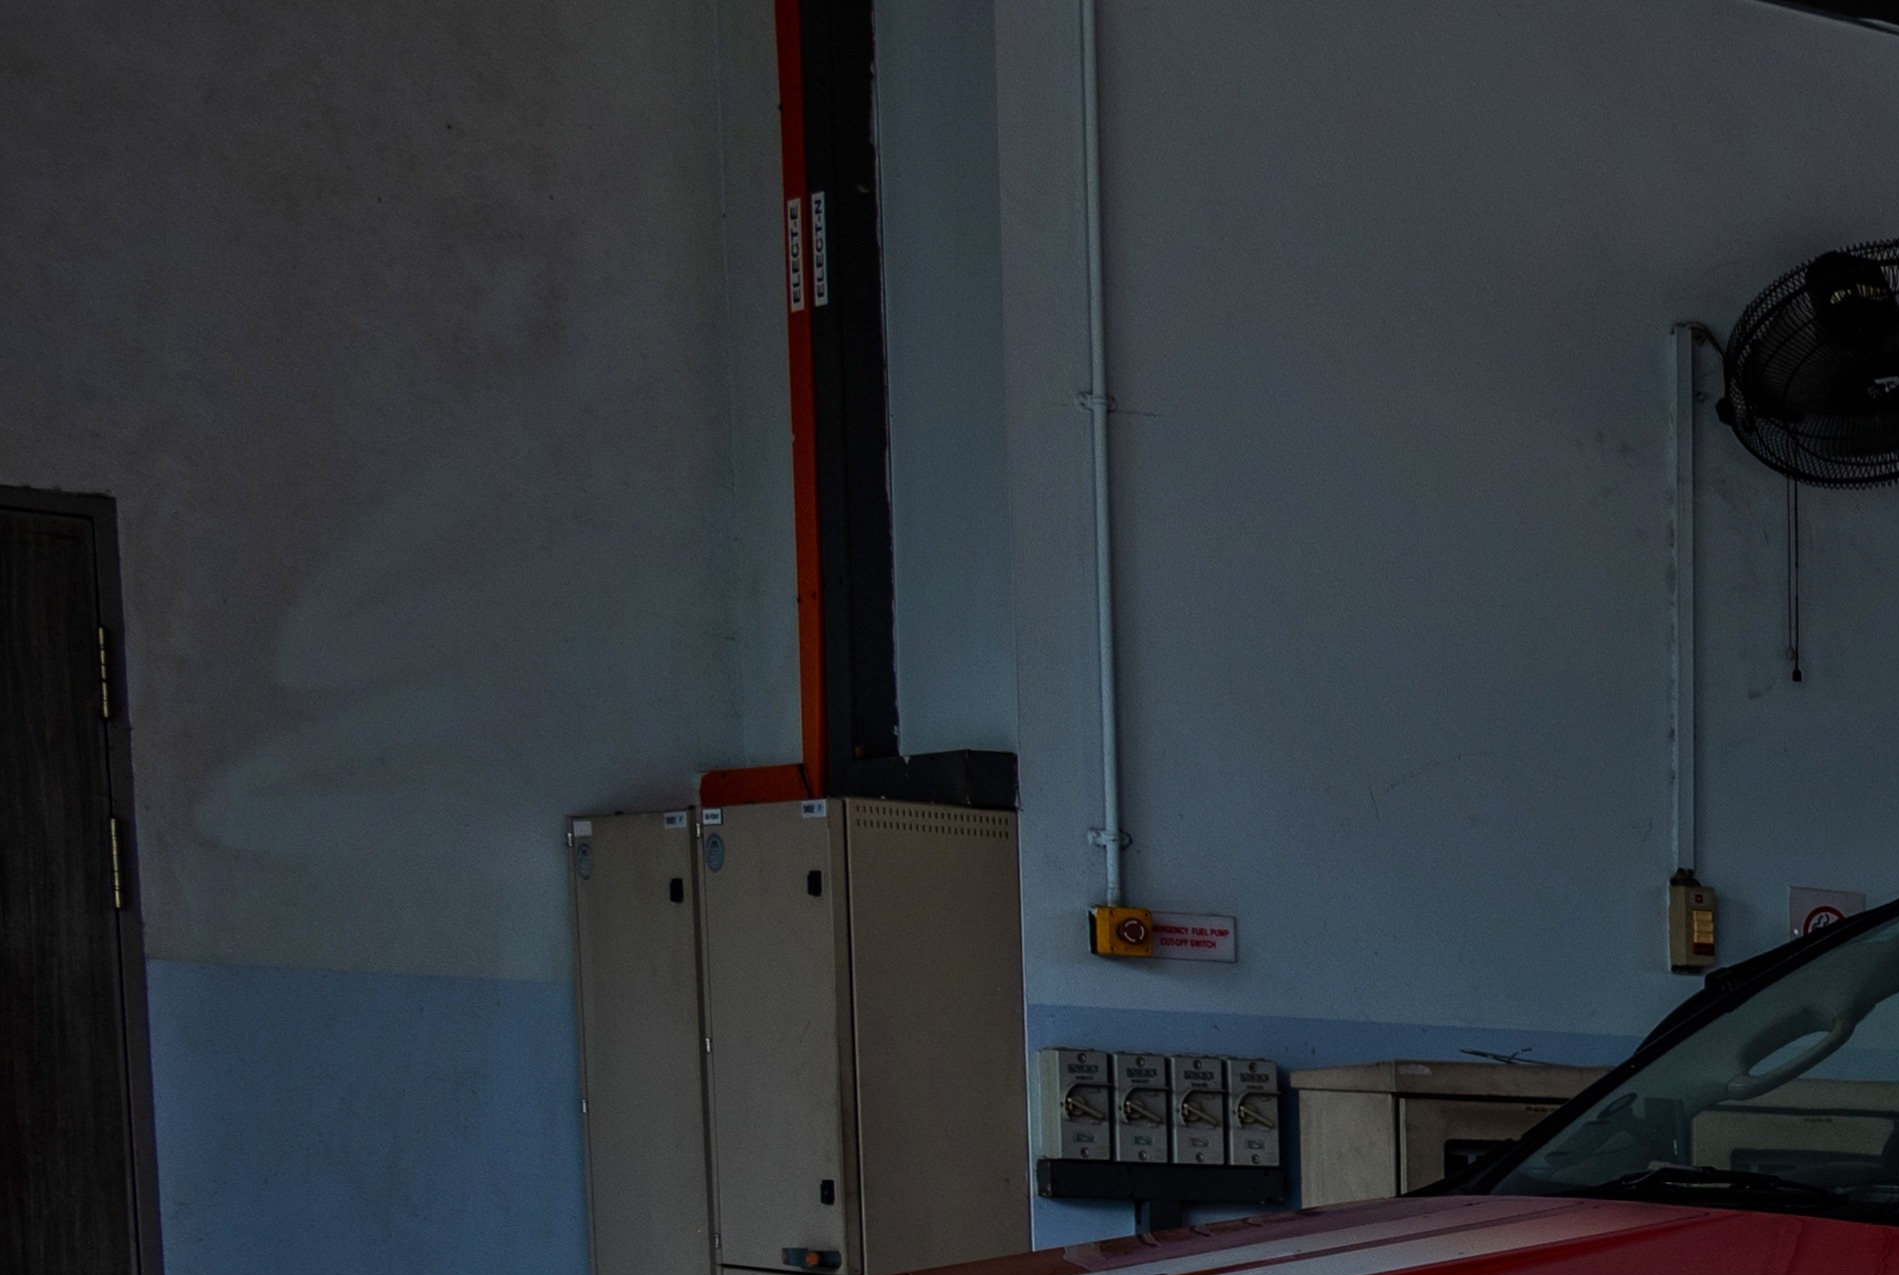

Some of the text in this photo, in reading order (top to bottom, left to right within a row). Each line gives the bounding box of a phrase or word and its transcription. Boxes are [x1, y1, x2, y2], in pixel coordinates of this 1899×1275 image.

[790, 205, 801, 304] ELECT-E
[814, 199, 825, 298] ELECT-N
[1152, 925, 1230, 938] MERGENCY FUEL PUMP
